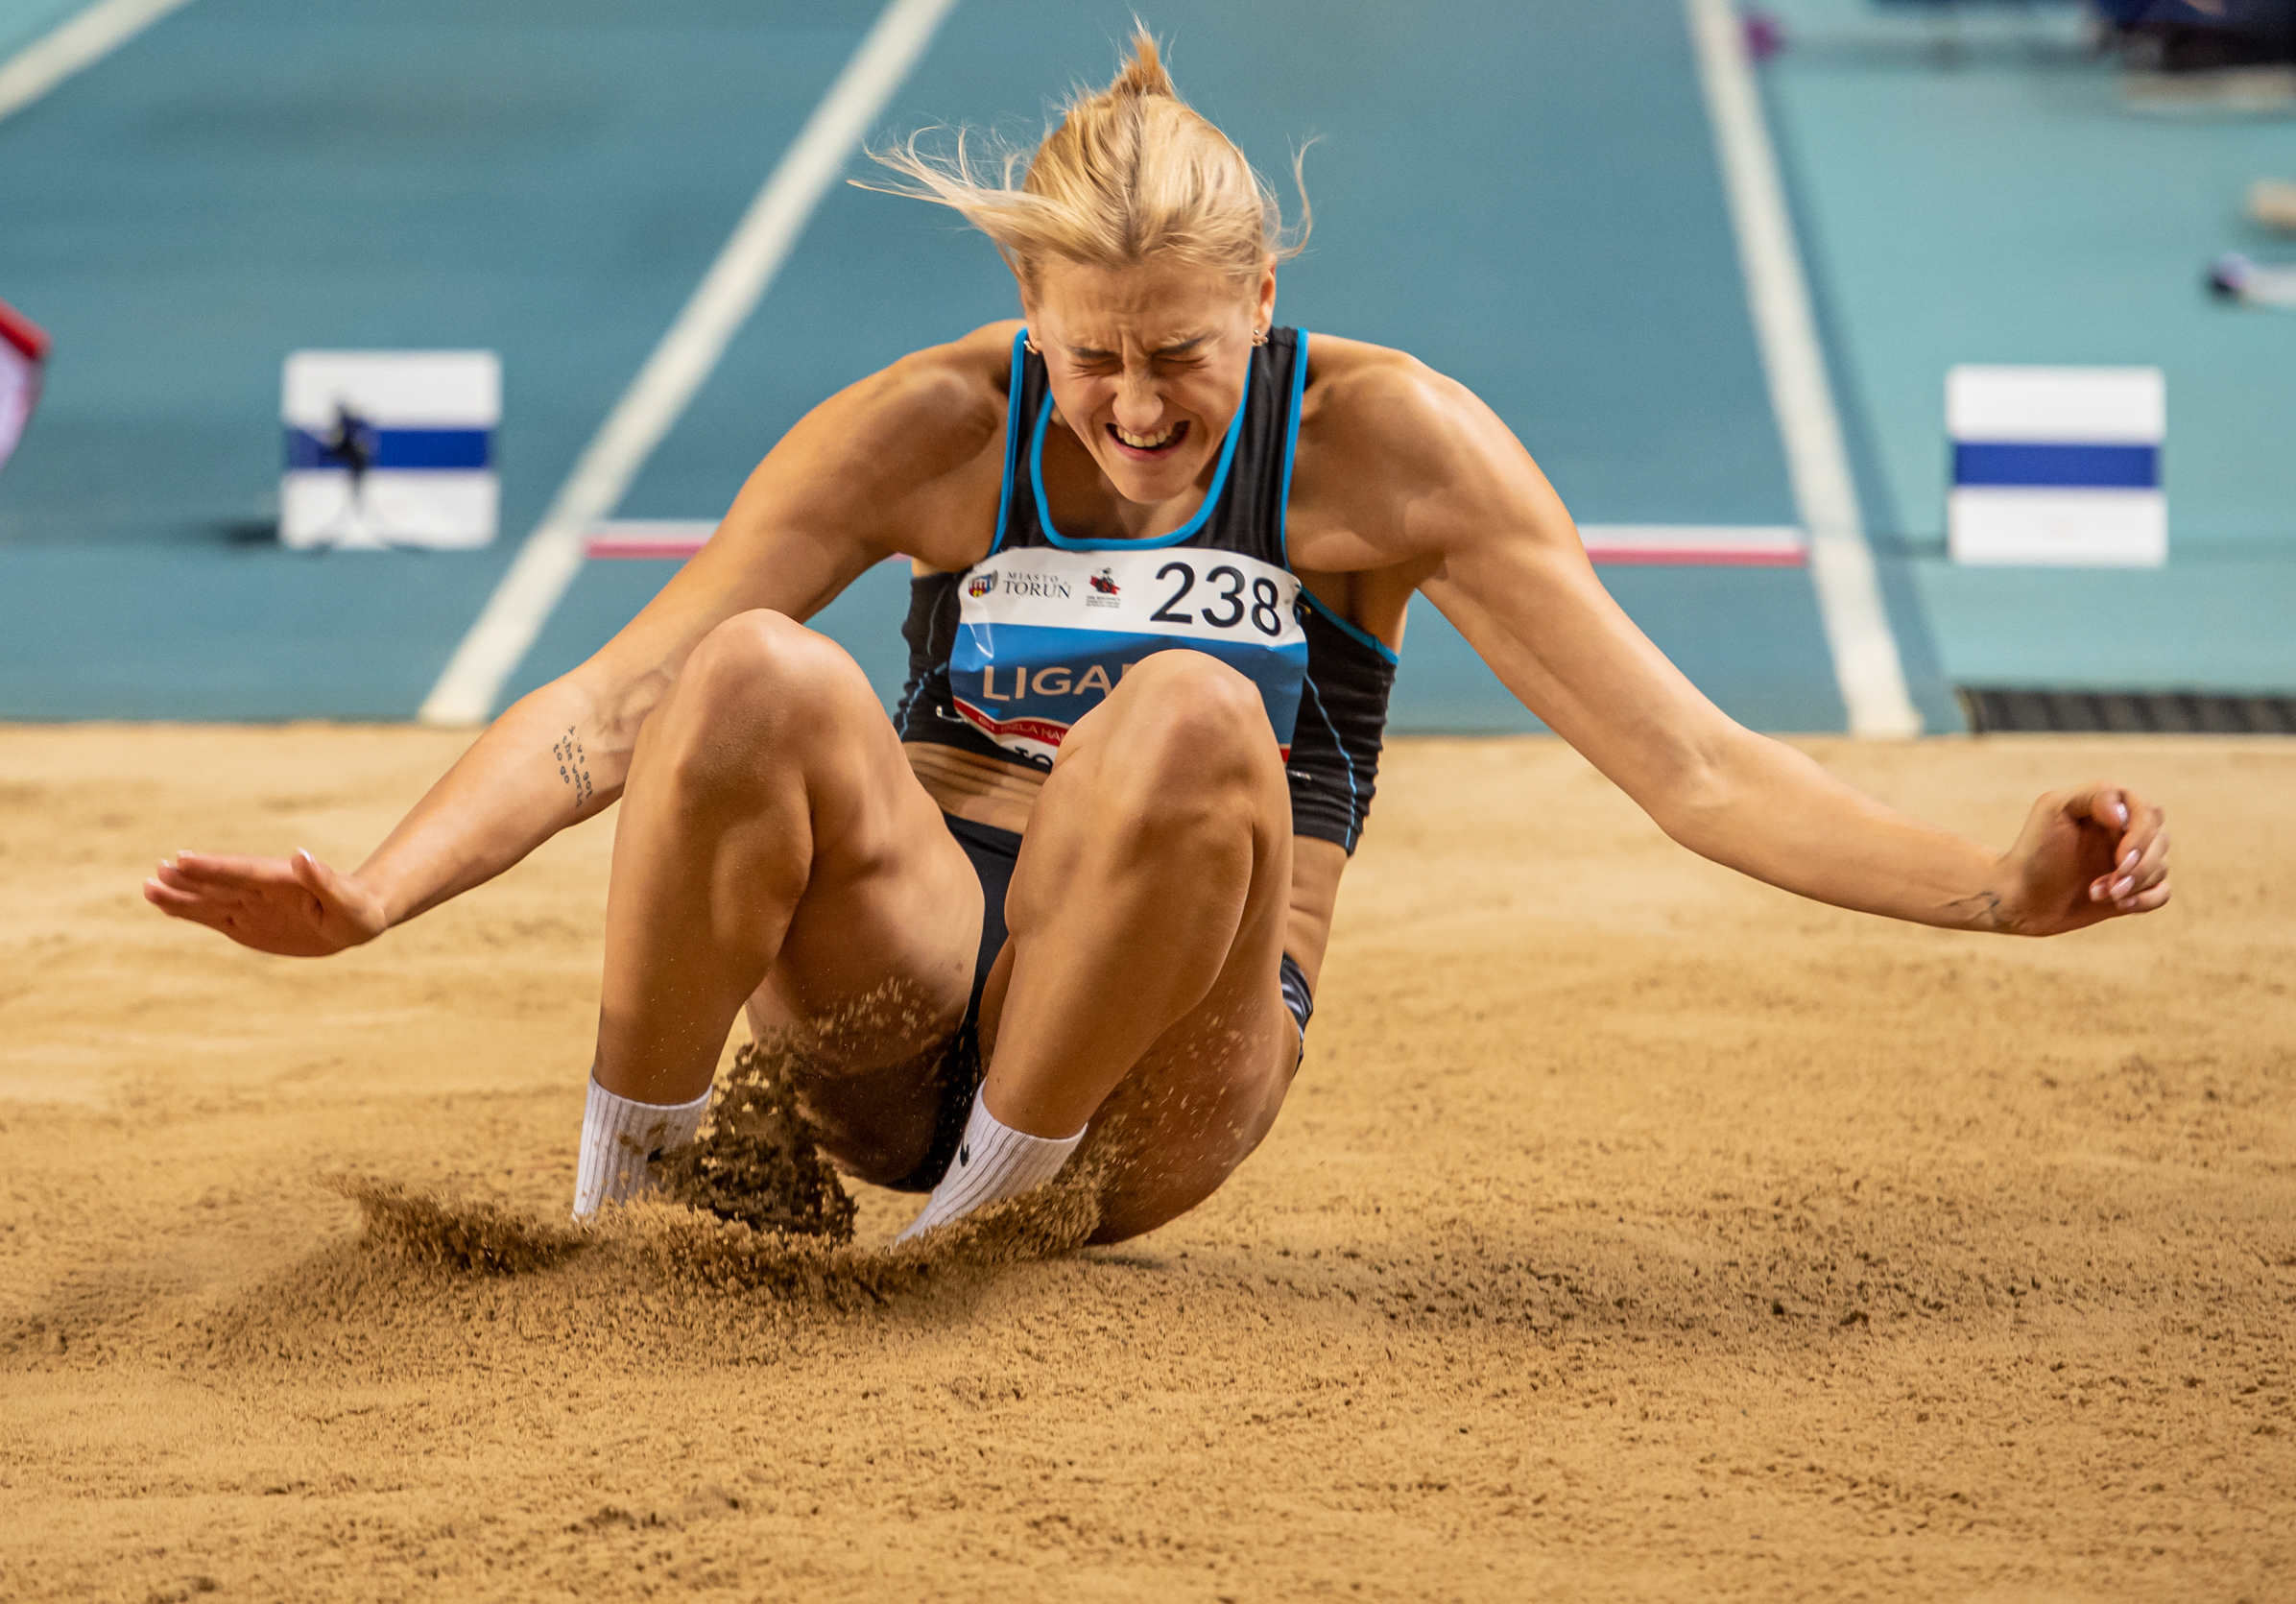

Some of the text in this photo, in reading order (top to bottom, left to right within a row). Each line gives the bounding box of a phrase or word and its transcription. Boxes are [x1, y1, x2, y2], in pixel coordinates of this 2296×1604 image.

[1007, 571, 1059, 582] MIASTO
[1149, 562, 1282, 636] 238
[982, 662, 1136, 702] LIGA
